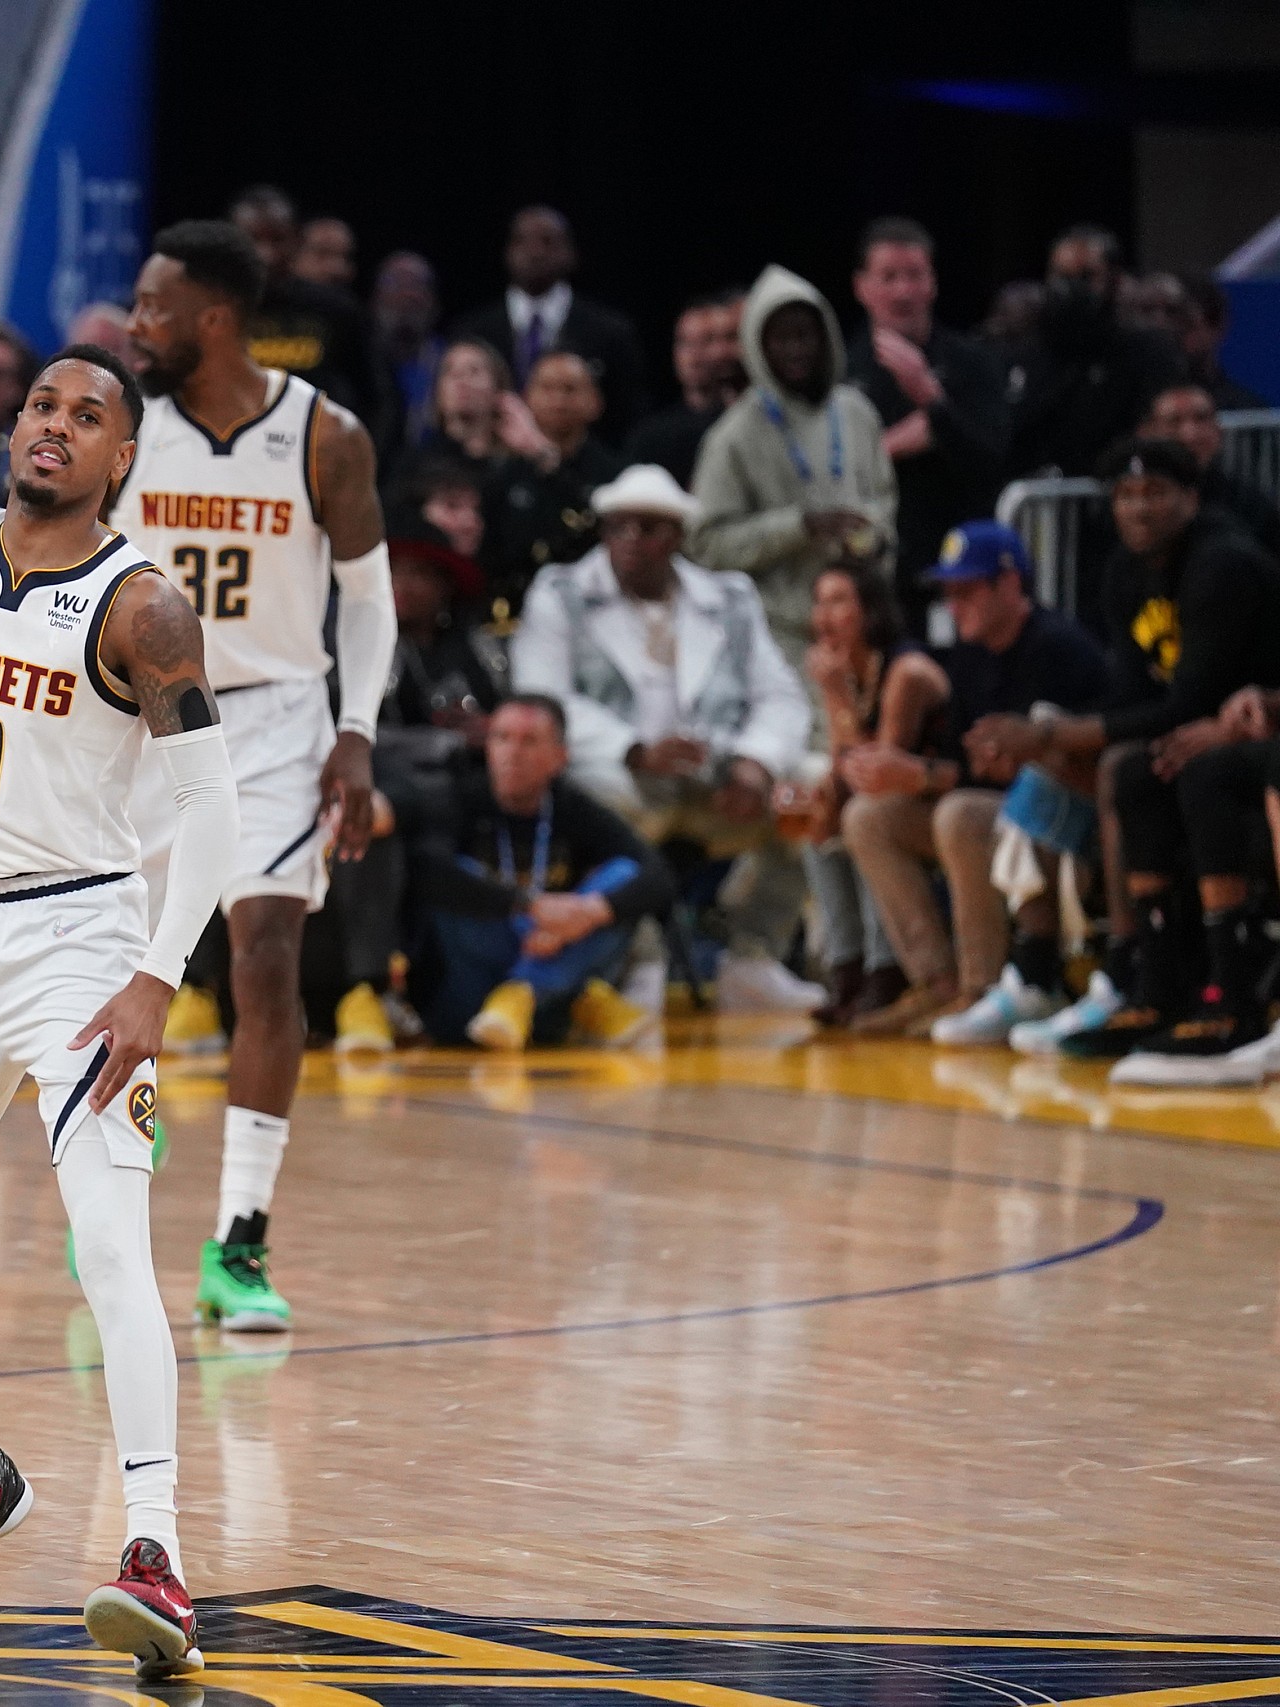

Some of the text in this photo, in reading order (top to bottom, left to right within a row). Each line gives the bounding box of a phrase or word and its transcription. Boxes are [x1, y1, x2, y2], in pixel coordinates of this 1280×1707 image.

[140, 491, 294, 538] NUGGETS
[173, 543, 252, 619] 32
[54, 590, 89, 614] WU
[47, 609, 81, 624] Western
[50, 618, 73, 631] Union
